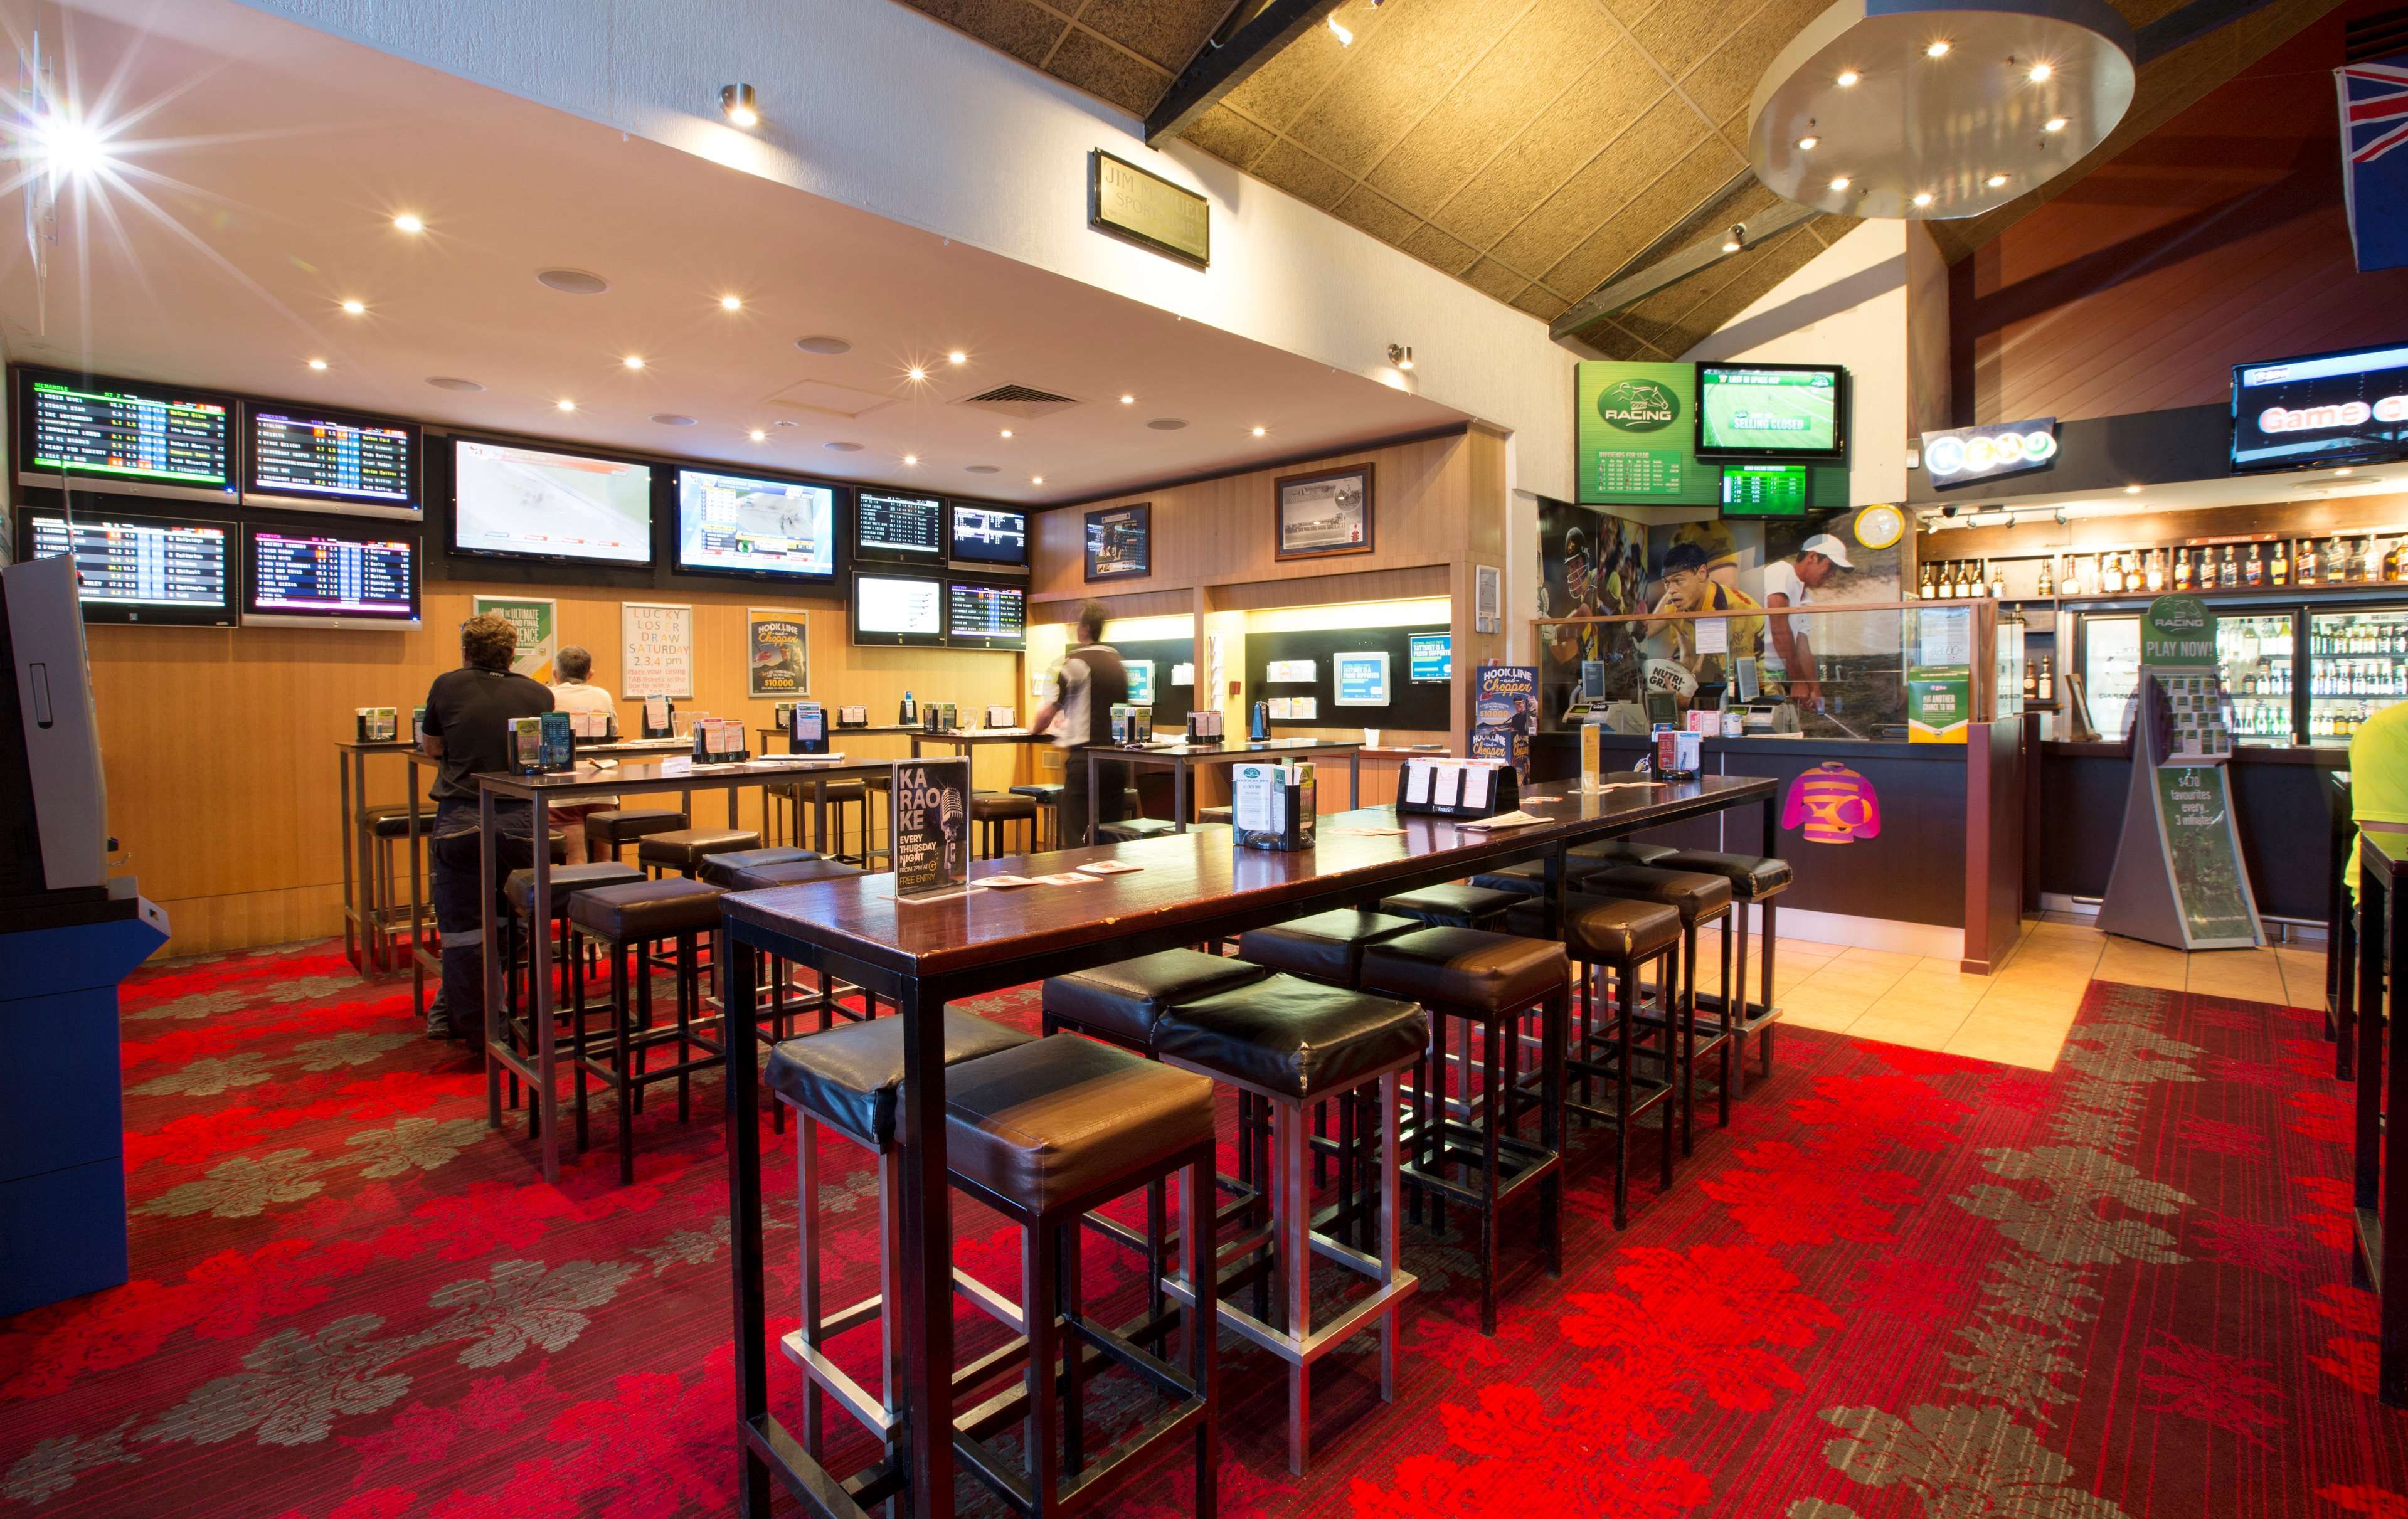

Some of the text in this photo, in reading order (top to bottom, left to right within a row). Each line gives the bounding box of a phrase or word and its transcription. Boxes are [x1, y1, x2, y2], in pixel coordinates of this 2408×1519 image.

[1105, 167, 1134, 192] JIM
[1605, 410, 1672, 421] RACING
[2264, 404, 2363, 431] Game
[1734, 419, 1804, 430] SELLING CLOSED
[511, 608, 539, 620] ULTIMATE
[634, 608, 681, 620] LUCKY
[523, 619, 539, 627] FINAL
[637, 620, 679, 632] LOSER
[516, 628, 540, 643] IENCE
[642, 632, 680, 643] DRAW
[758, 632, 798, 647] Chopper
[629, 643, 690, 655] SATURDAY
[2146, 641, 2214, 657] PLAY NOW!
[666, 657, 682, 666] pm
[1652, 667, 1685, 685] NUTRI-
[1483, 677, 1532, 697] Chopper
[1649, 675, 1681, 691] GRAN
[1473, 741, 1506, 758] Chopper
[899, 767, 928, 790] KA
[899, 787, 941, 811] RAO
[2170, 789, 2212, 800] favourites
[2181, 803, 2205, 814] every
[899, 809, 924, 832] KE
[2175, 814, 2214, 826] 3 minutes
[899, 834, 923, 844] EVERY
[899, 842, 937, 854] THURSDAY
[899, 852, 925, 865] NIGHT
[899, 864, 913, 874] FROM
[913, 864, 923, 872] 7PM
[899, 875, 915, 886] FREE
[915, 872, 936, 884] ENTRY
